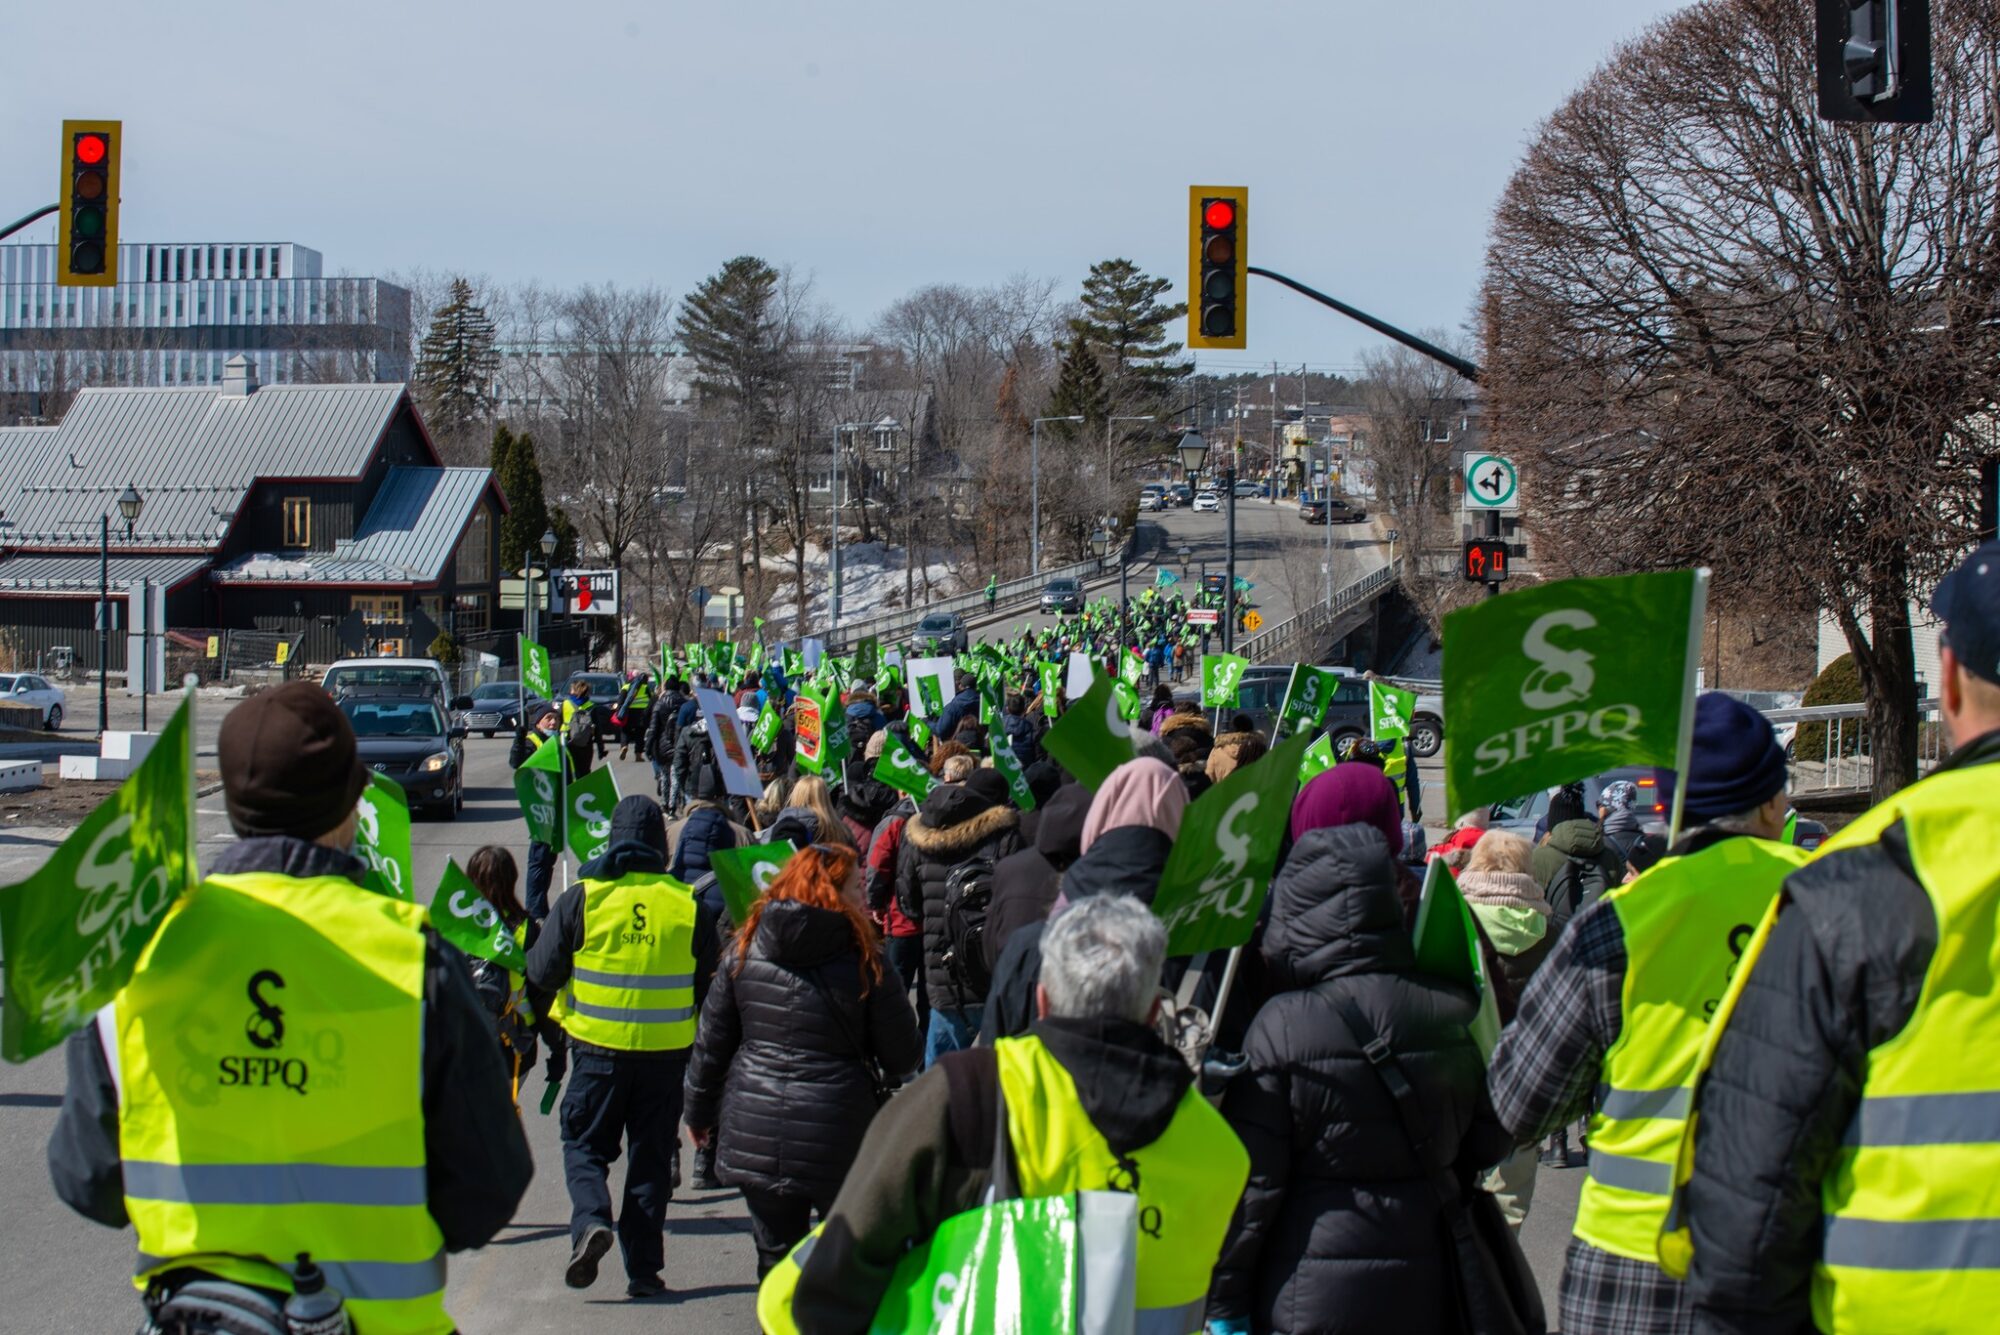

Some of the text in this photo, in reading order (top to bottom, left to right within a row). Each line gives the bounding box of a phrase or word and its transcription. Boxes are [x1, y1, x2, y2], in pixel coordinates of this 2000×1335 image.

[1291, 699, 1320, 720] SFPQ
[1473, 703, 1642, 776] SFPQ
[41, 865, 169, 1024] SFPQ
[622, 932, 656, 948] SFPQ
[219, 1056, 308, 1095] SFPQ
